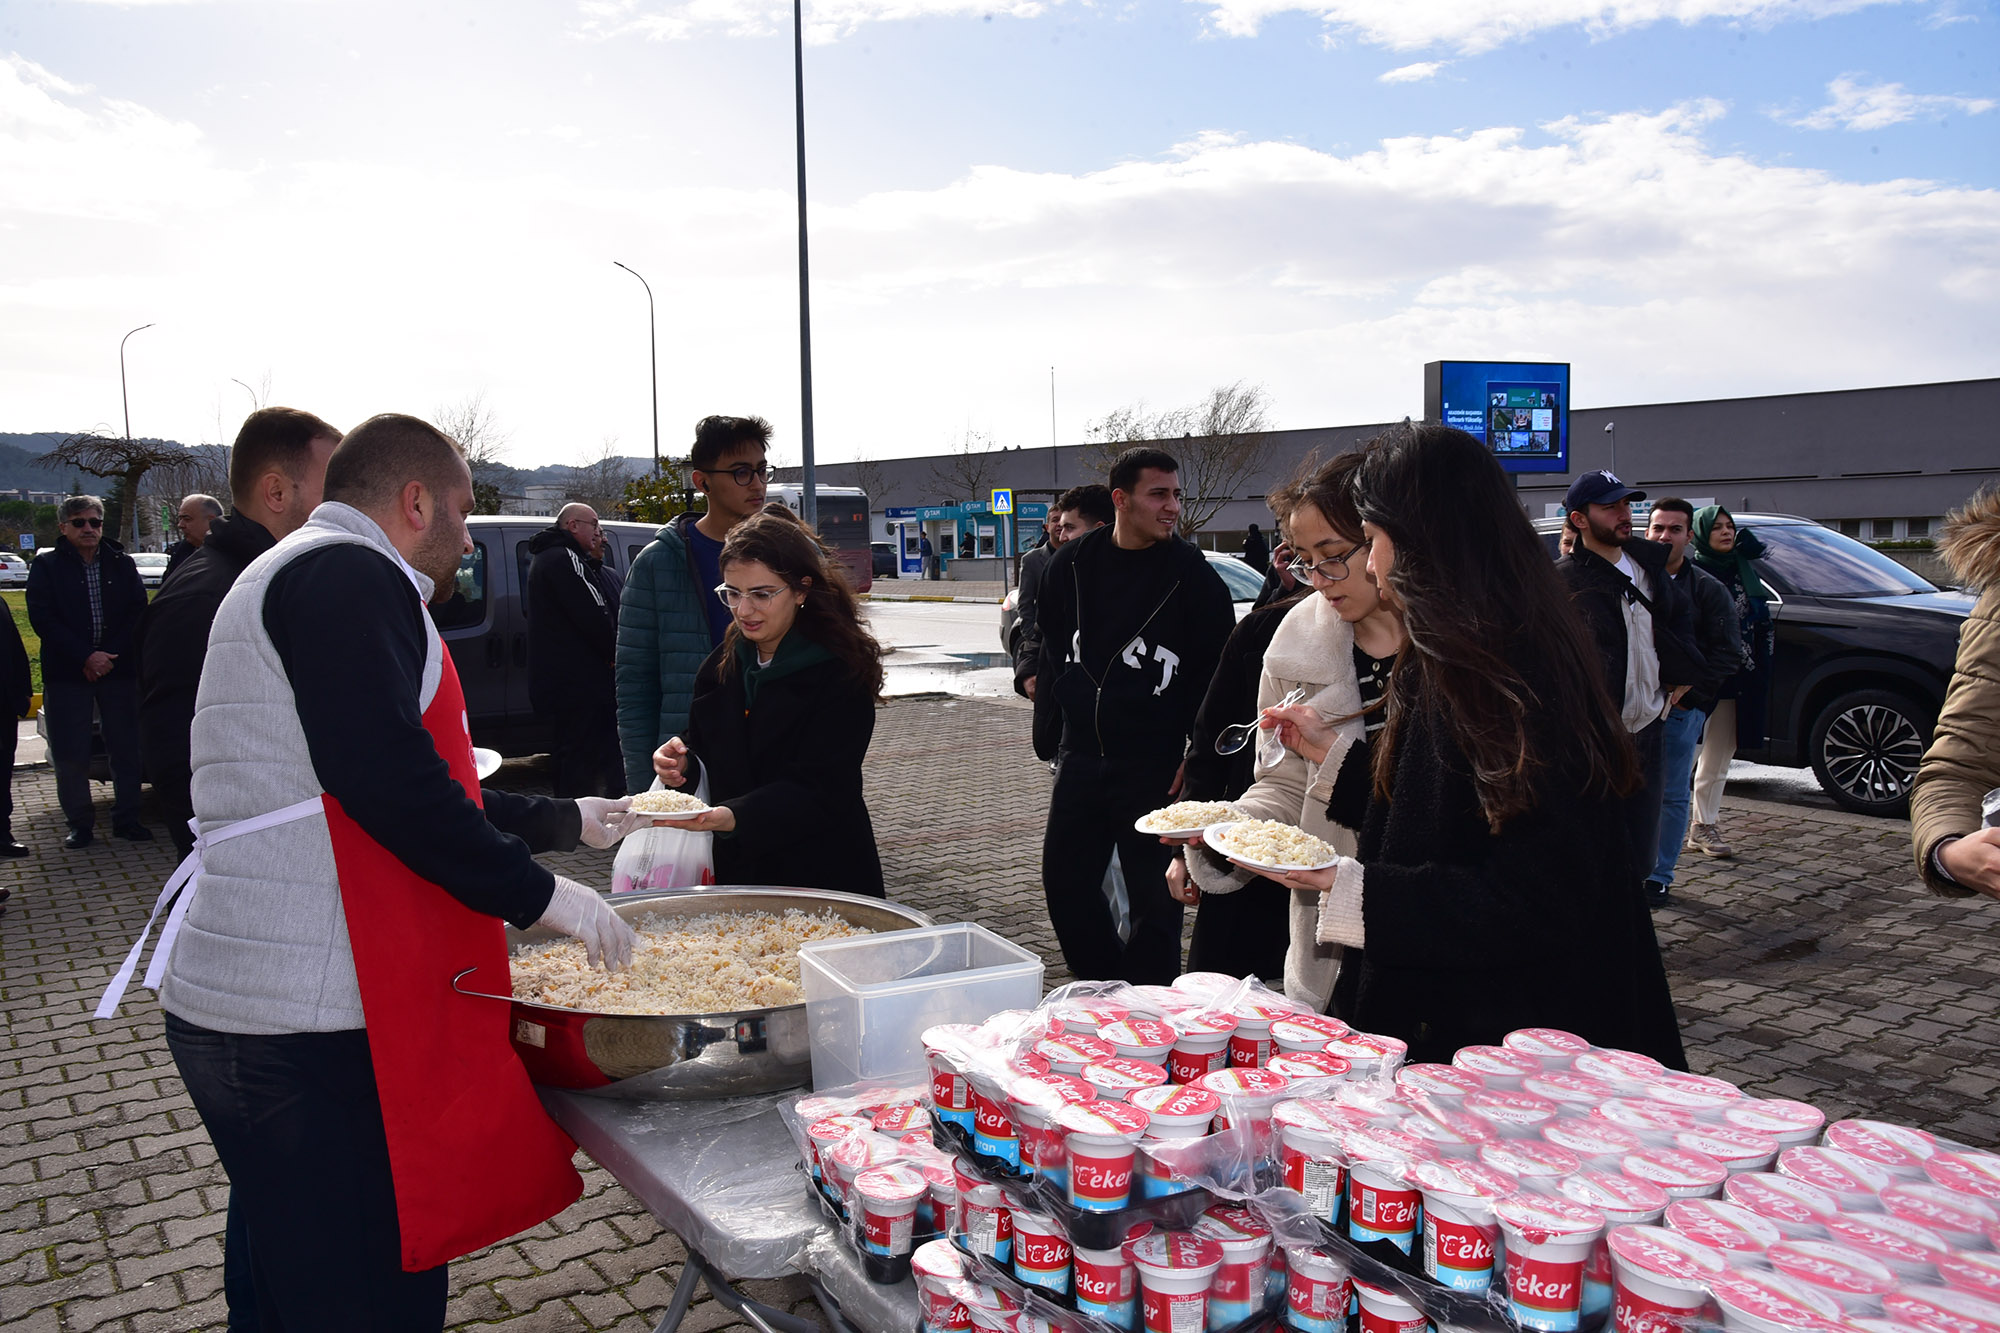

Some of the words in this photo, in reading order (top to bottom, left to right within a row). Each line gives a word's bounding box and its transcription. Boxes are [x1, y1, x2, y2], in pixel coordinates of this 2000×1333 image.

[1231, 1043, 1254, 1063] ker
[1170, 1058, 1200, 1078] ker
[934, 1083, 950, 1098] er
[976, 1138, 996, 1153] yran
[1089, 1167, 1132, 1188] eker
[1396, 1202, 1418, 1222] ek
[1043, 1244, 1072, 1263] eke
[1459, 1236, 1494, 1259] eke
[1076, 1273, 1116, 1294] eker
[1453, 1275, 1489, 1288] Ayran
[1516, 1274, 1572, 1299] eker
[1290, 1286, 1308, 1304] er
[1144, 1304, 1158, 1320] er
